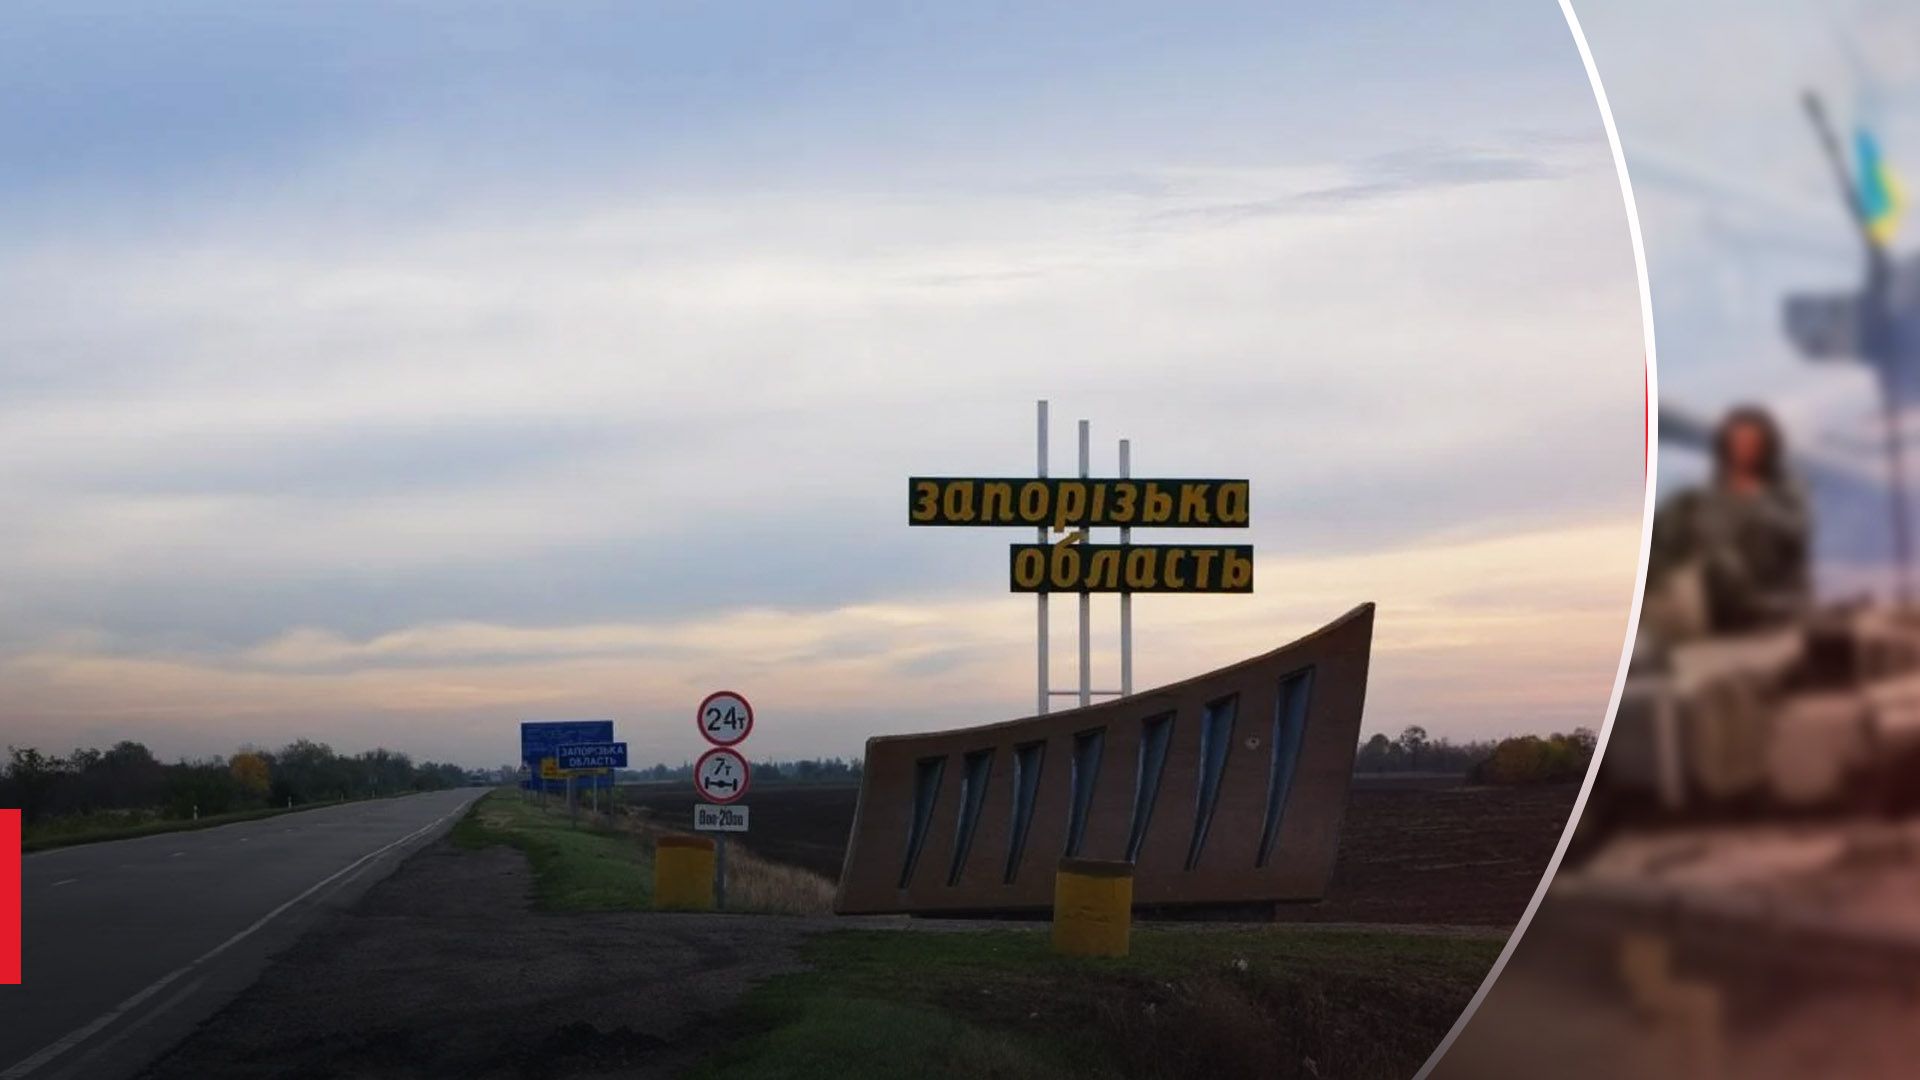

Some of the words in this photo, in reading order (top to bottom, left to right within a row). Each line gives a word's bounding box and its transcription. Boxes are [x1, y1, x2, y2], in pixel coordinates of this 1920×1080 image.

[912, 480, 1249, 533] запорізька
[1014, 531, 1251, 589] область
[568, 757, 617, 767] ОБЛАСТЬ
